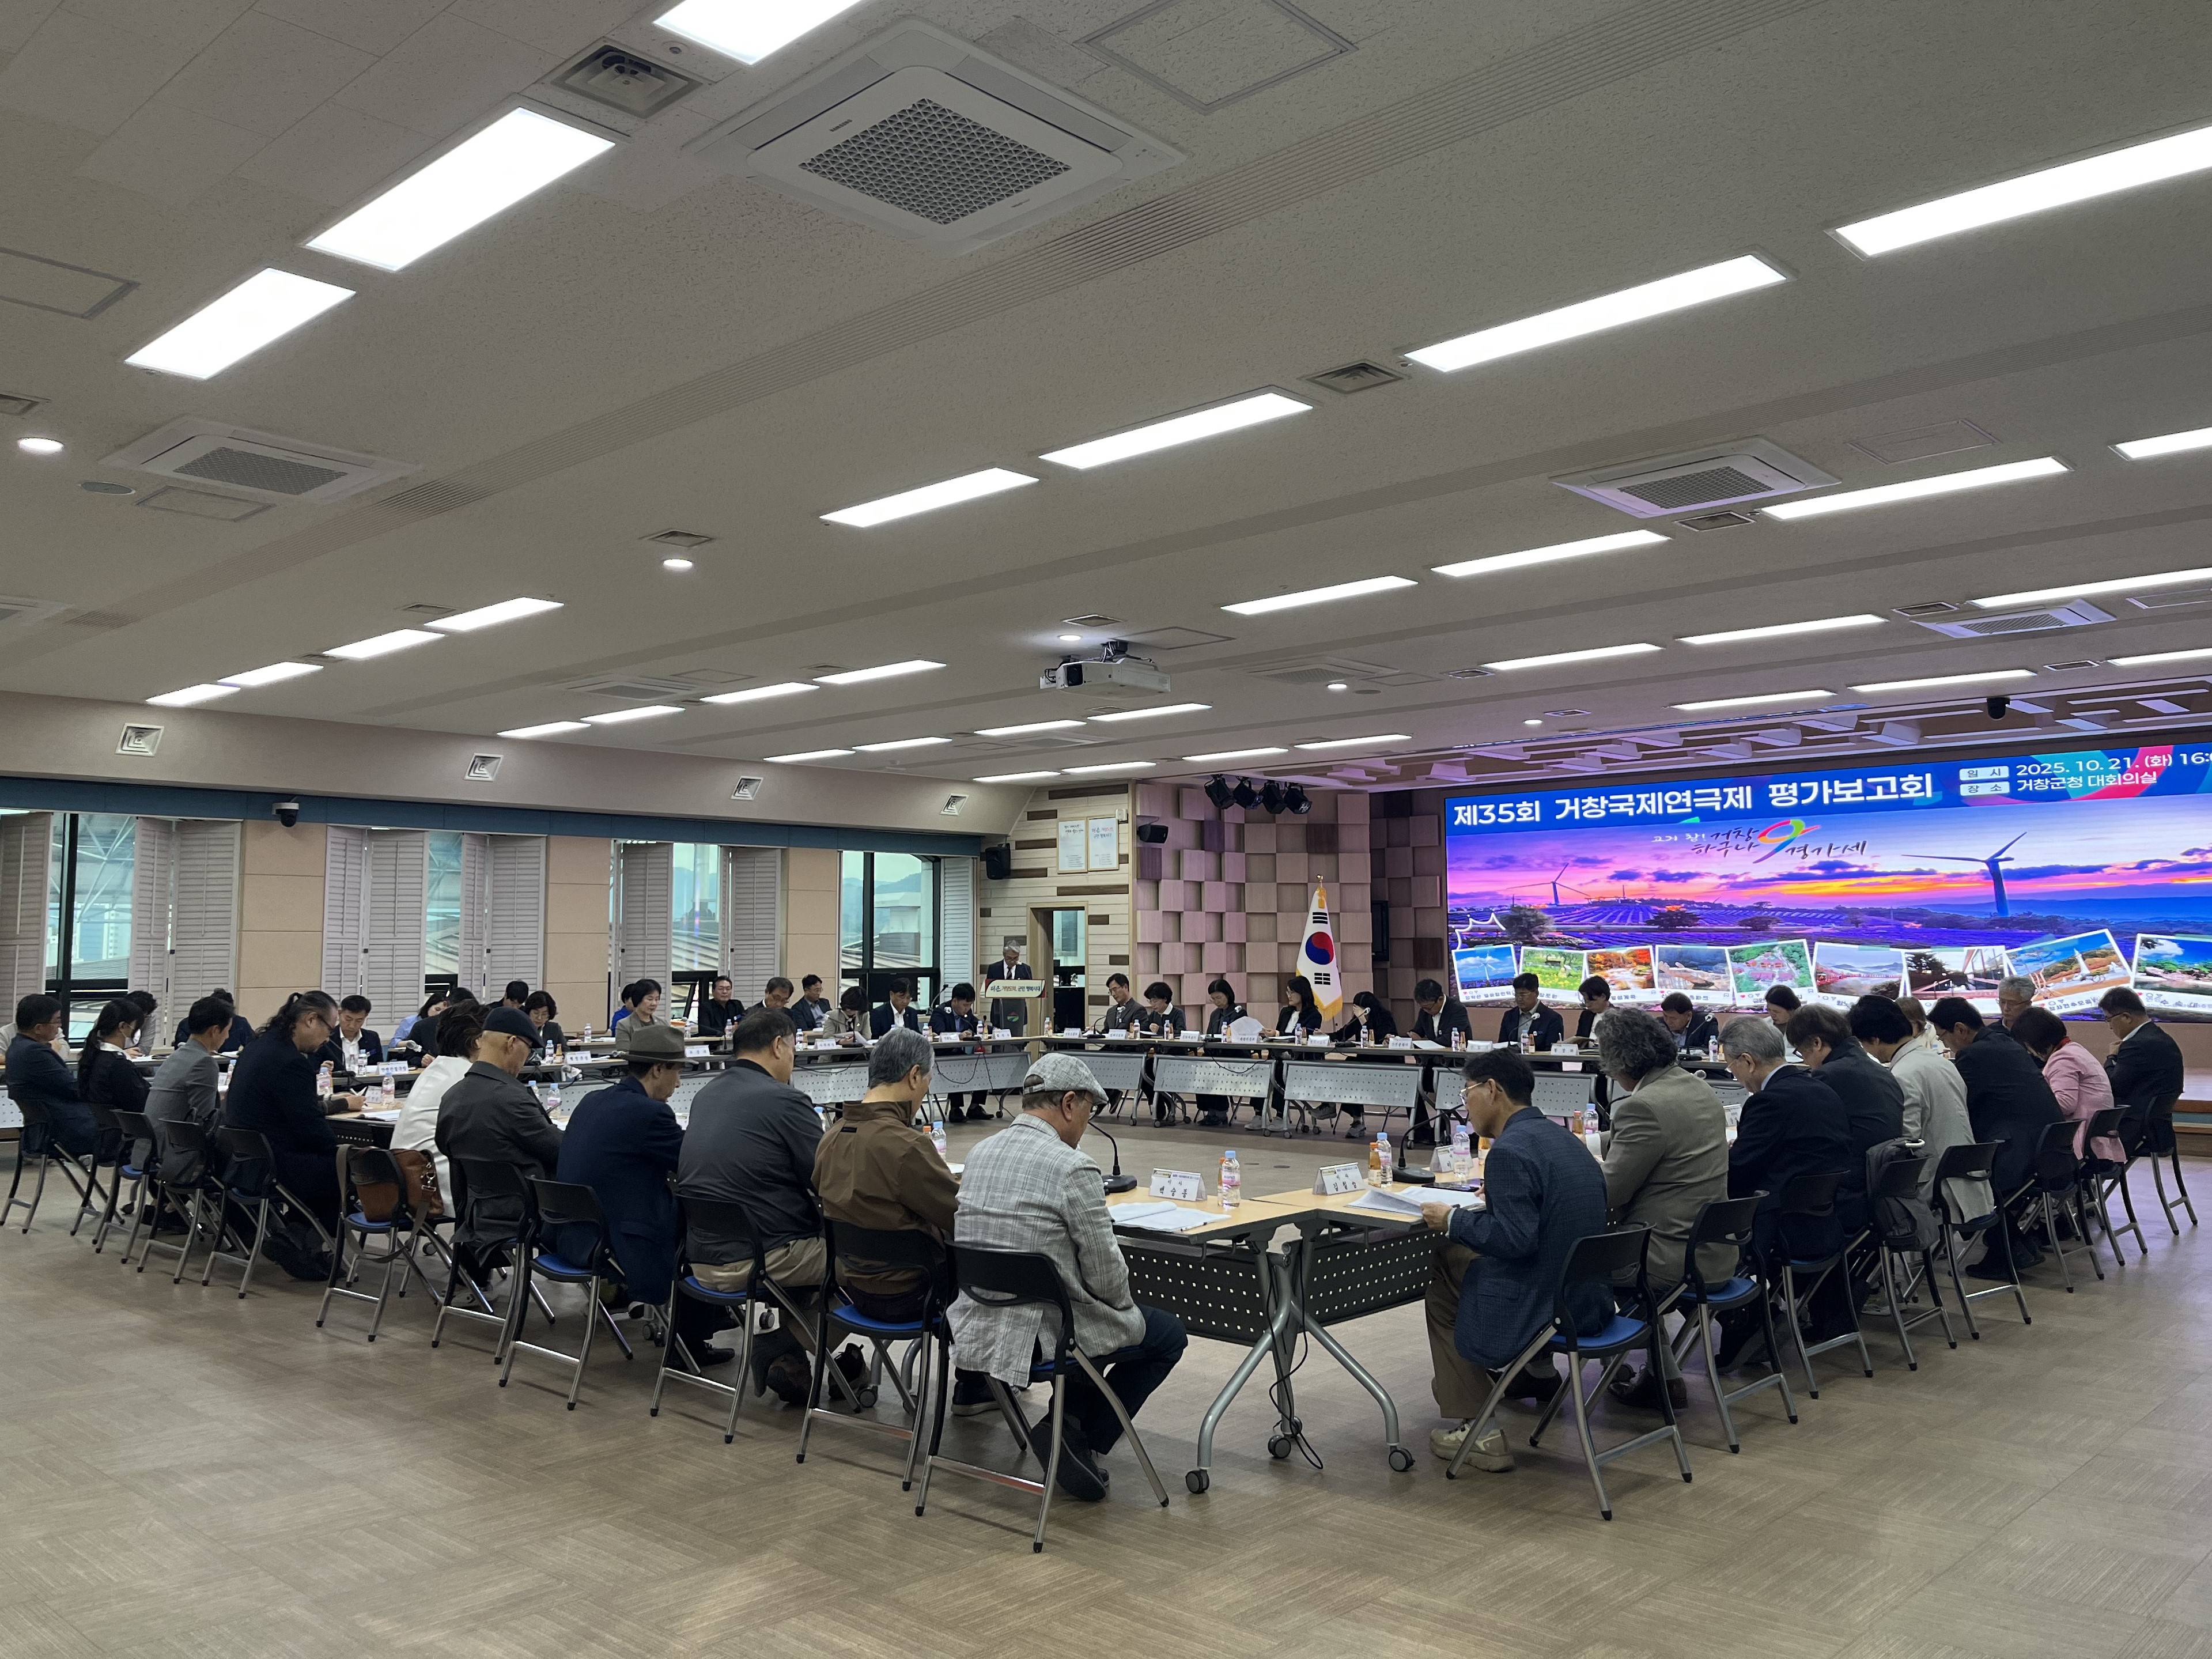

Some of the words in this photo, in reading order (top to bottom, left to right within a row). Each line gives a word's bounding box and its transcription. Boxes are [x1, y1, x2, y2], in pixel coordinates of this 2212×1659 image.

[2016, 762, 2070, 776] 2025.
[2078, 759, 2103, 772] 10.
[2108, 757, 2139, 770] 21.
[2145, 754, 2172, 768] (화)
[2179, 752, 2212, 765] 16:
[2017, 776, 2084, 792] 거창군청
[2088, 770, 2158, 788] 대회의실
[1454, 800, 1540, 825] 제35회
[1555, 785, 1752, 819] 거창국제연극제
[1768, 773, 1933, 807] 평가보고회
